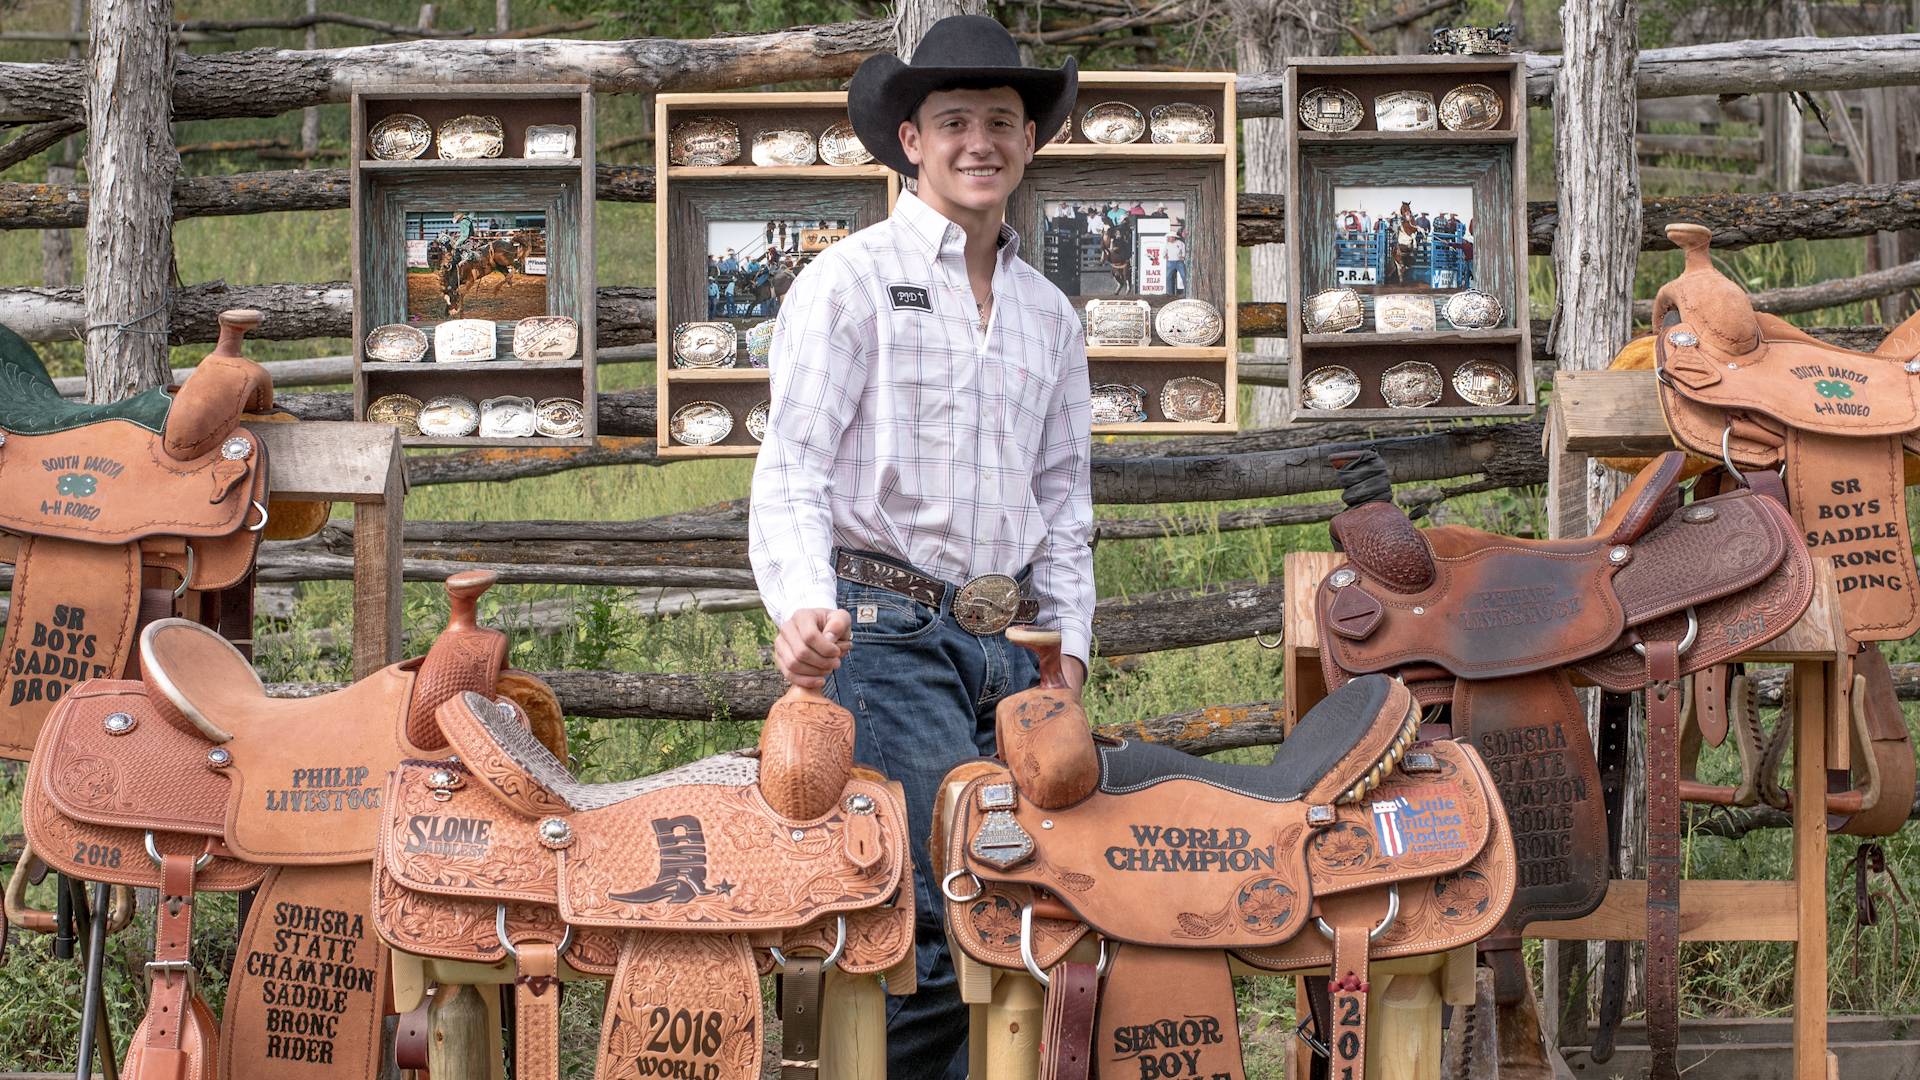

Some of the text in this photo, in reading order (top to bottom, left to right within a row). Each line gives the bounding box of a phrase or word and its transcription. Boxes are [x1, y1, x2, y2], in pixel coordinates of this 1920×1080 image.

[1790, 364, 1868, 384] SOUTH DAKOTA
[1814, 402, 1870, 417] 4-H RODEO
[42, 455, 125, 480] SOUTH DAKOTA
[1831, 478, 1862, 495] SR
[40, 500, 101, 521] 4-H RODEO
[1818, 499, 1880, 520] BOYS
[1806, 521, 1899, 547] SADDLE
[1831, 549, 1897, 569] RONC
[1836, 574, 1902, 594] DING
[52, 604, 86, 631] SR
[31, 622, 97, 658] BOYS
[9, 678, 73, 706] BRO
[1480, 722, 1568, 758] SDHSRA
[292, 766, 369, 788] PHILIP
[1489, 753, 1567, 784] STATE
[1501, 777, 1588, 810] AMPION
[404, 815, 493, 853] SLONE
[1129, 824, 1251, 849] WORLD
[1516, 833, 1573, 860] RONC
[73, 841, 122, 868] 2018
[1104, 844, 1275, 872] CHAMPION
[1519, 859, 1571, 888] IDER
[273, 902, 364, 939] SDHSRA
[273, 928, 357, 964] STATE
[246, 951, 377, 993] CHAMPION
[262, 980, 348, 1014] SADDLE
[266, 1008, 339, 1039] BRONC
[646, 1006, 723, 1057] 2018
[1112, 1015, 1224, 1060] SENIOR
[266, 1034, 334, 1064] RIDER
[635, 1055, 720, 1080] WORLD
[1138, 1048, 1202, 1080] BOY
